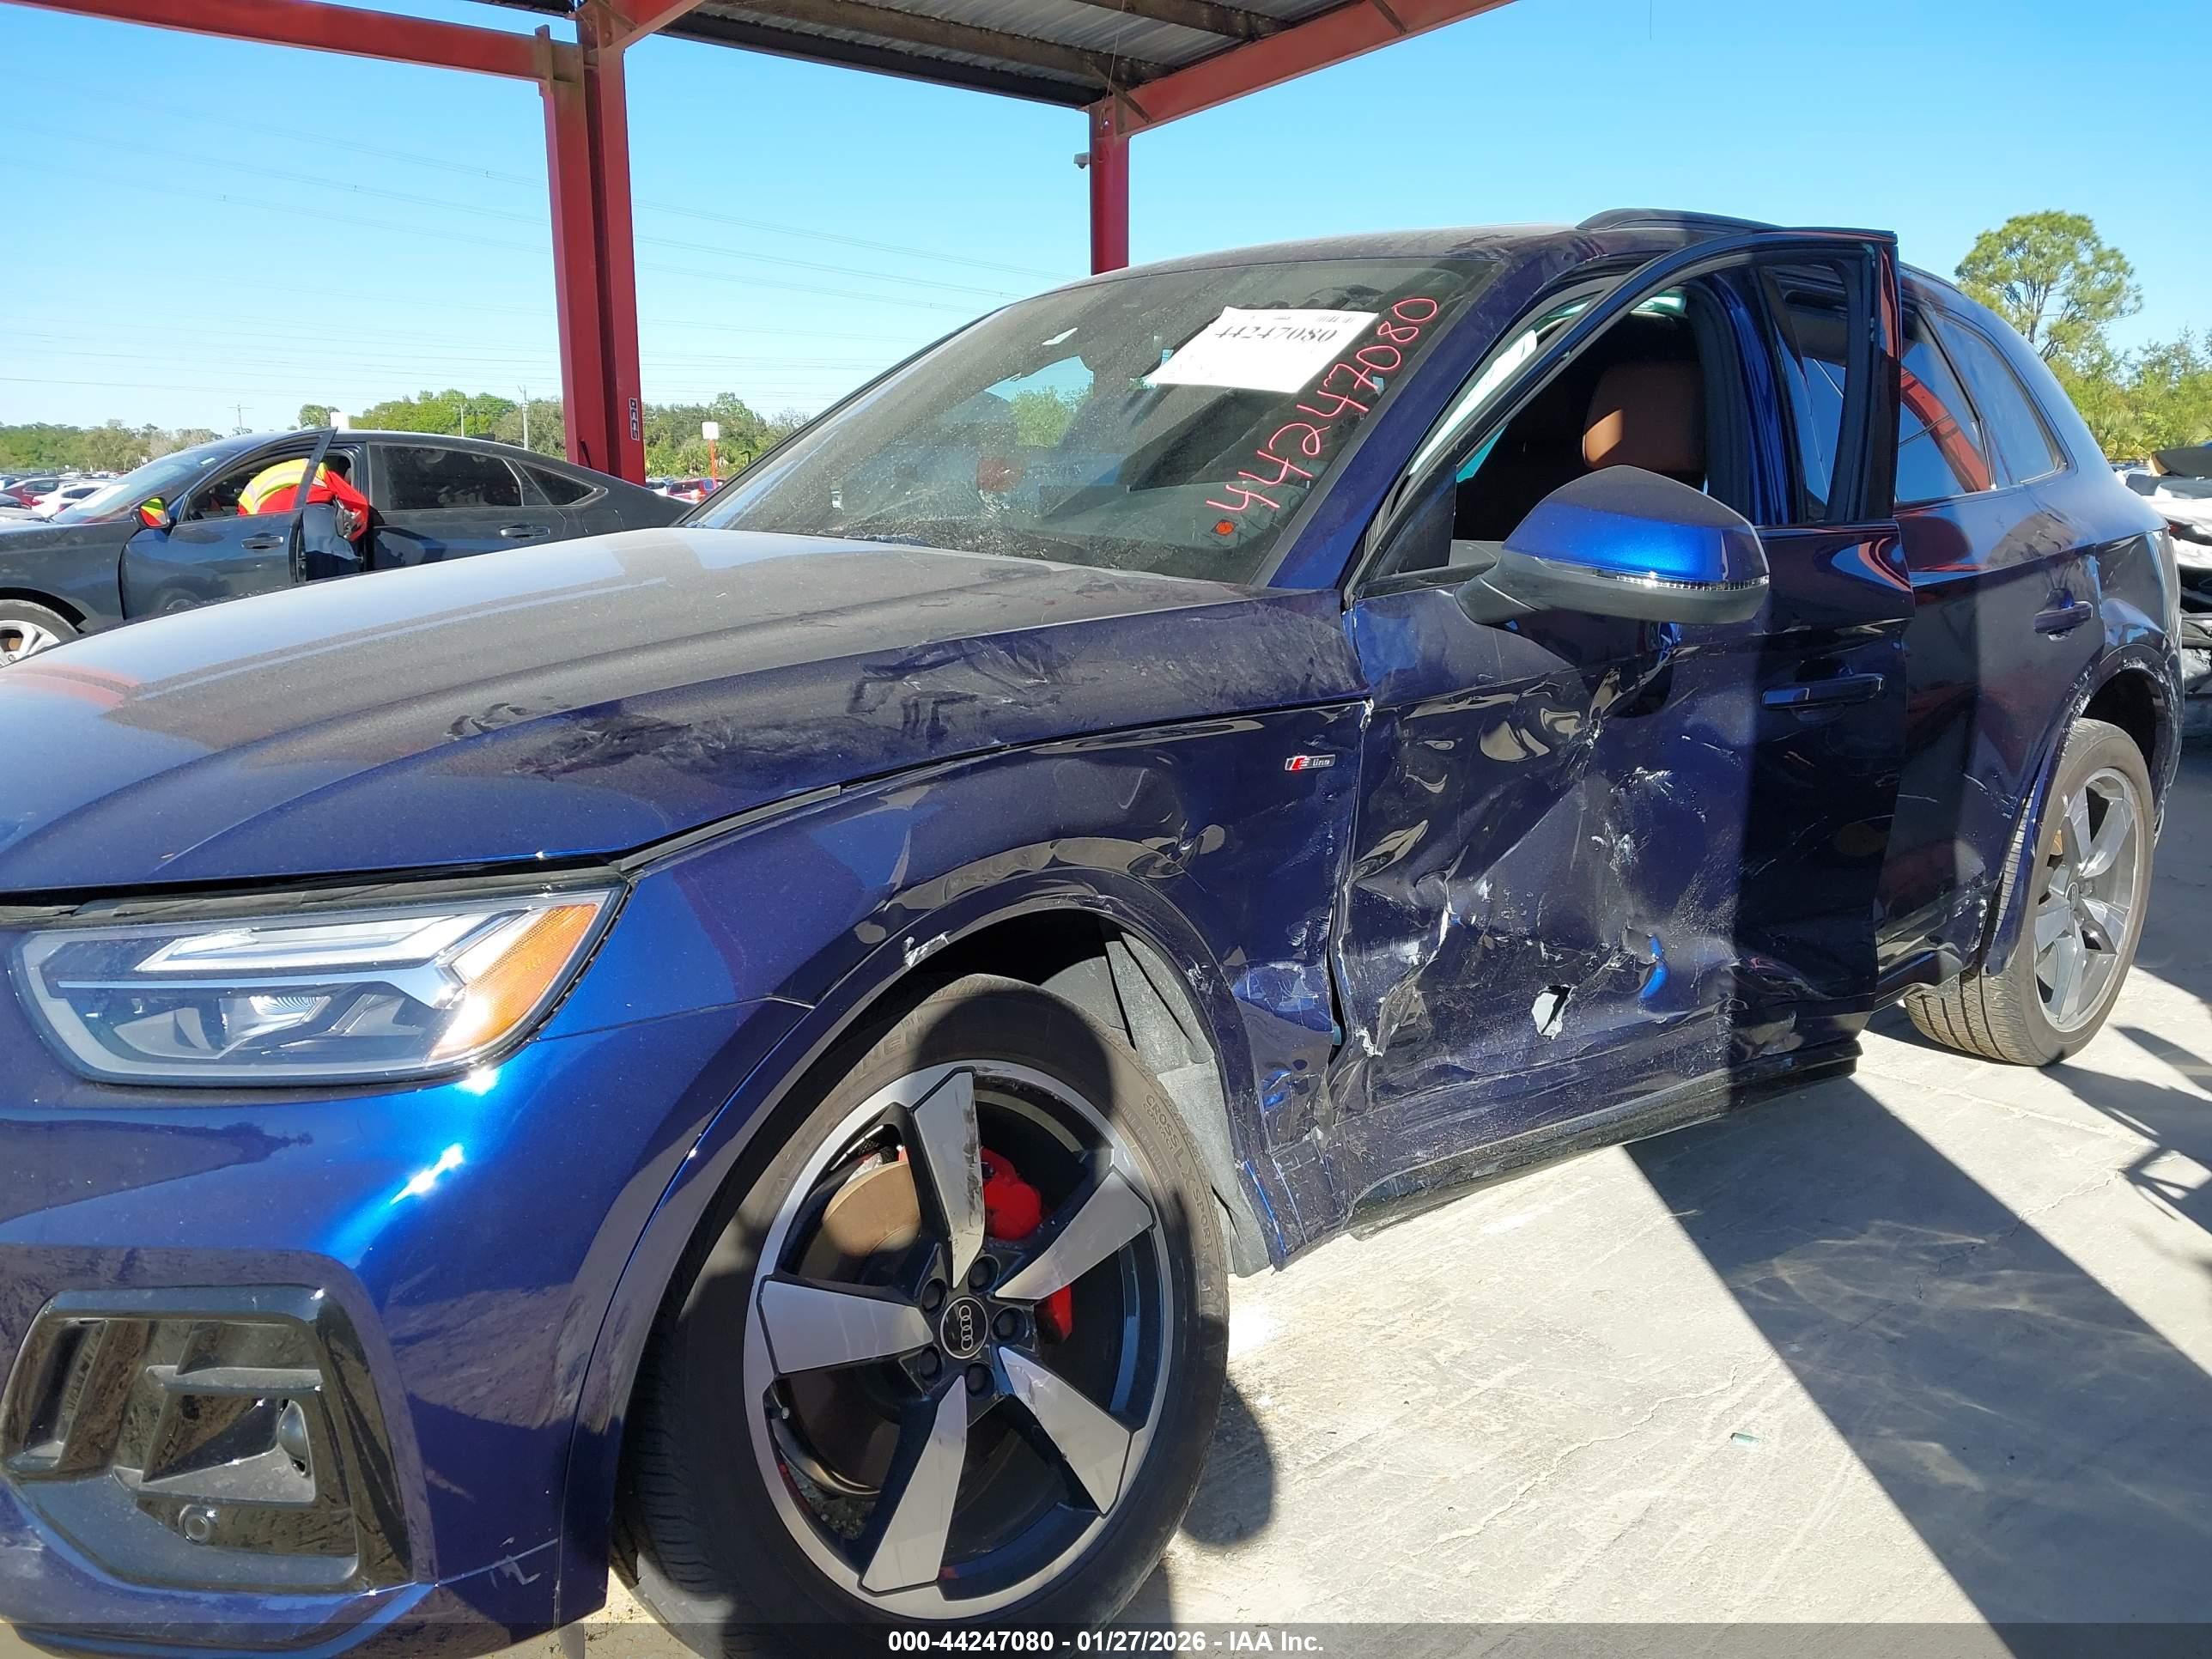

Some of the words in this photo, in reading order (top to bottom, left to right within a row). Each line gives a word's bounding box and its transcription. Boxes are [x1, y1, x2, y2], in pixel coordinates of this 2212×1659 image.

[1215, 325, 1338, 343] 44247080
[1206, 298, 1438, 511] 44247080
[1145, 1094, 1182, 1149] CROSS
[1193, 1188, 1212, 1249] SPORT
